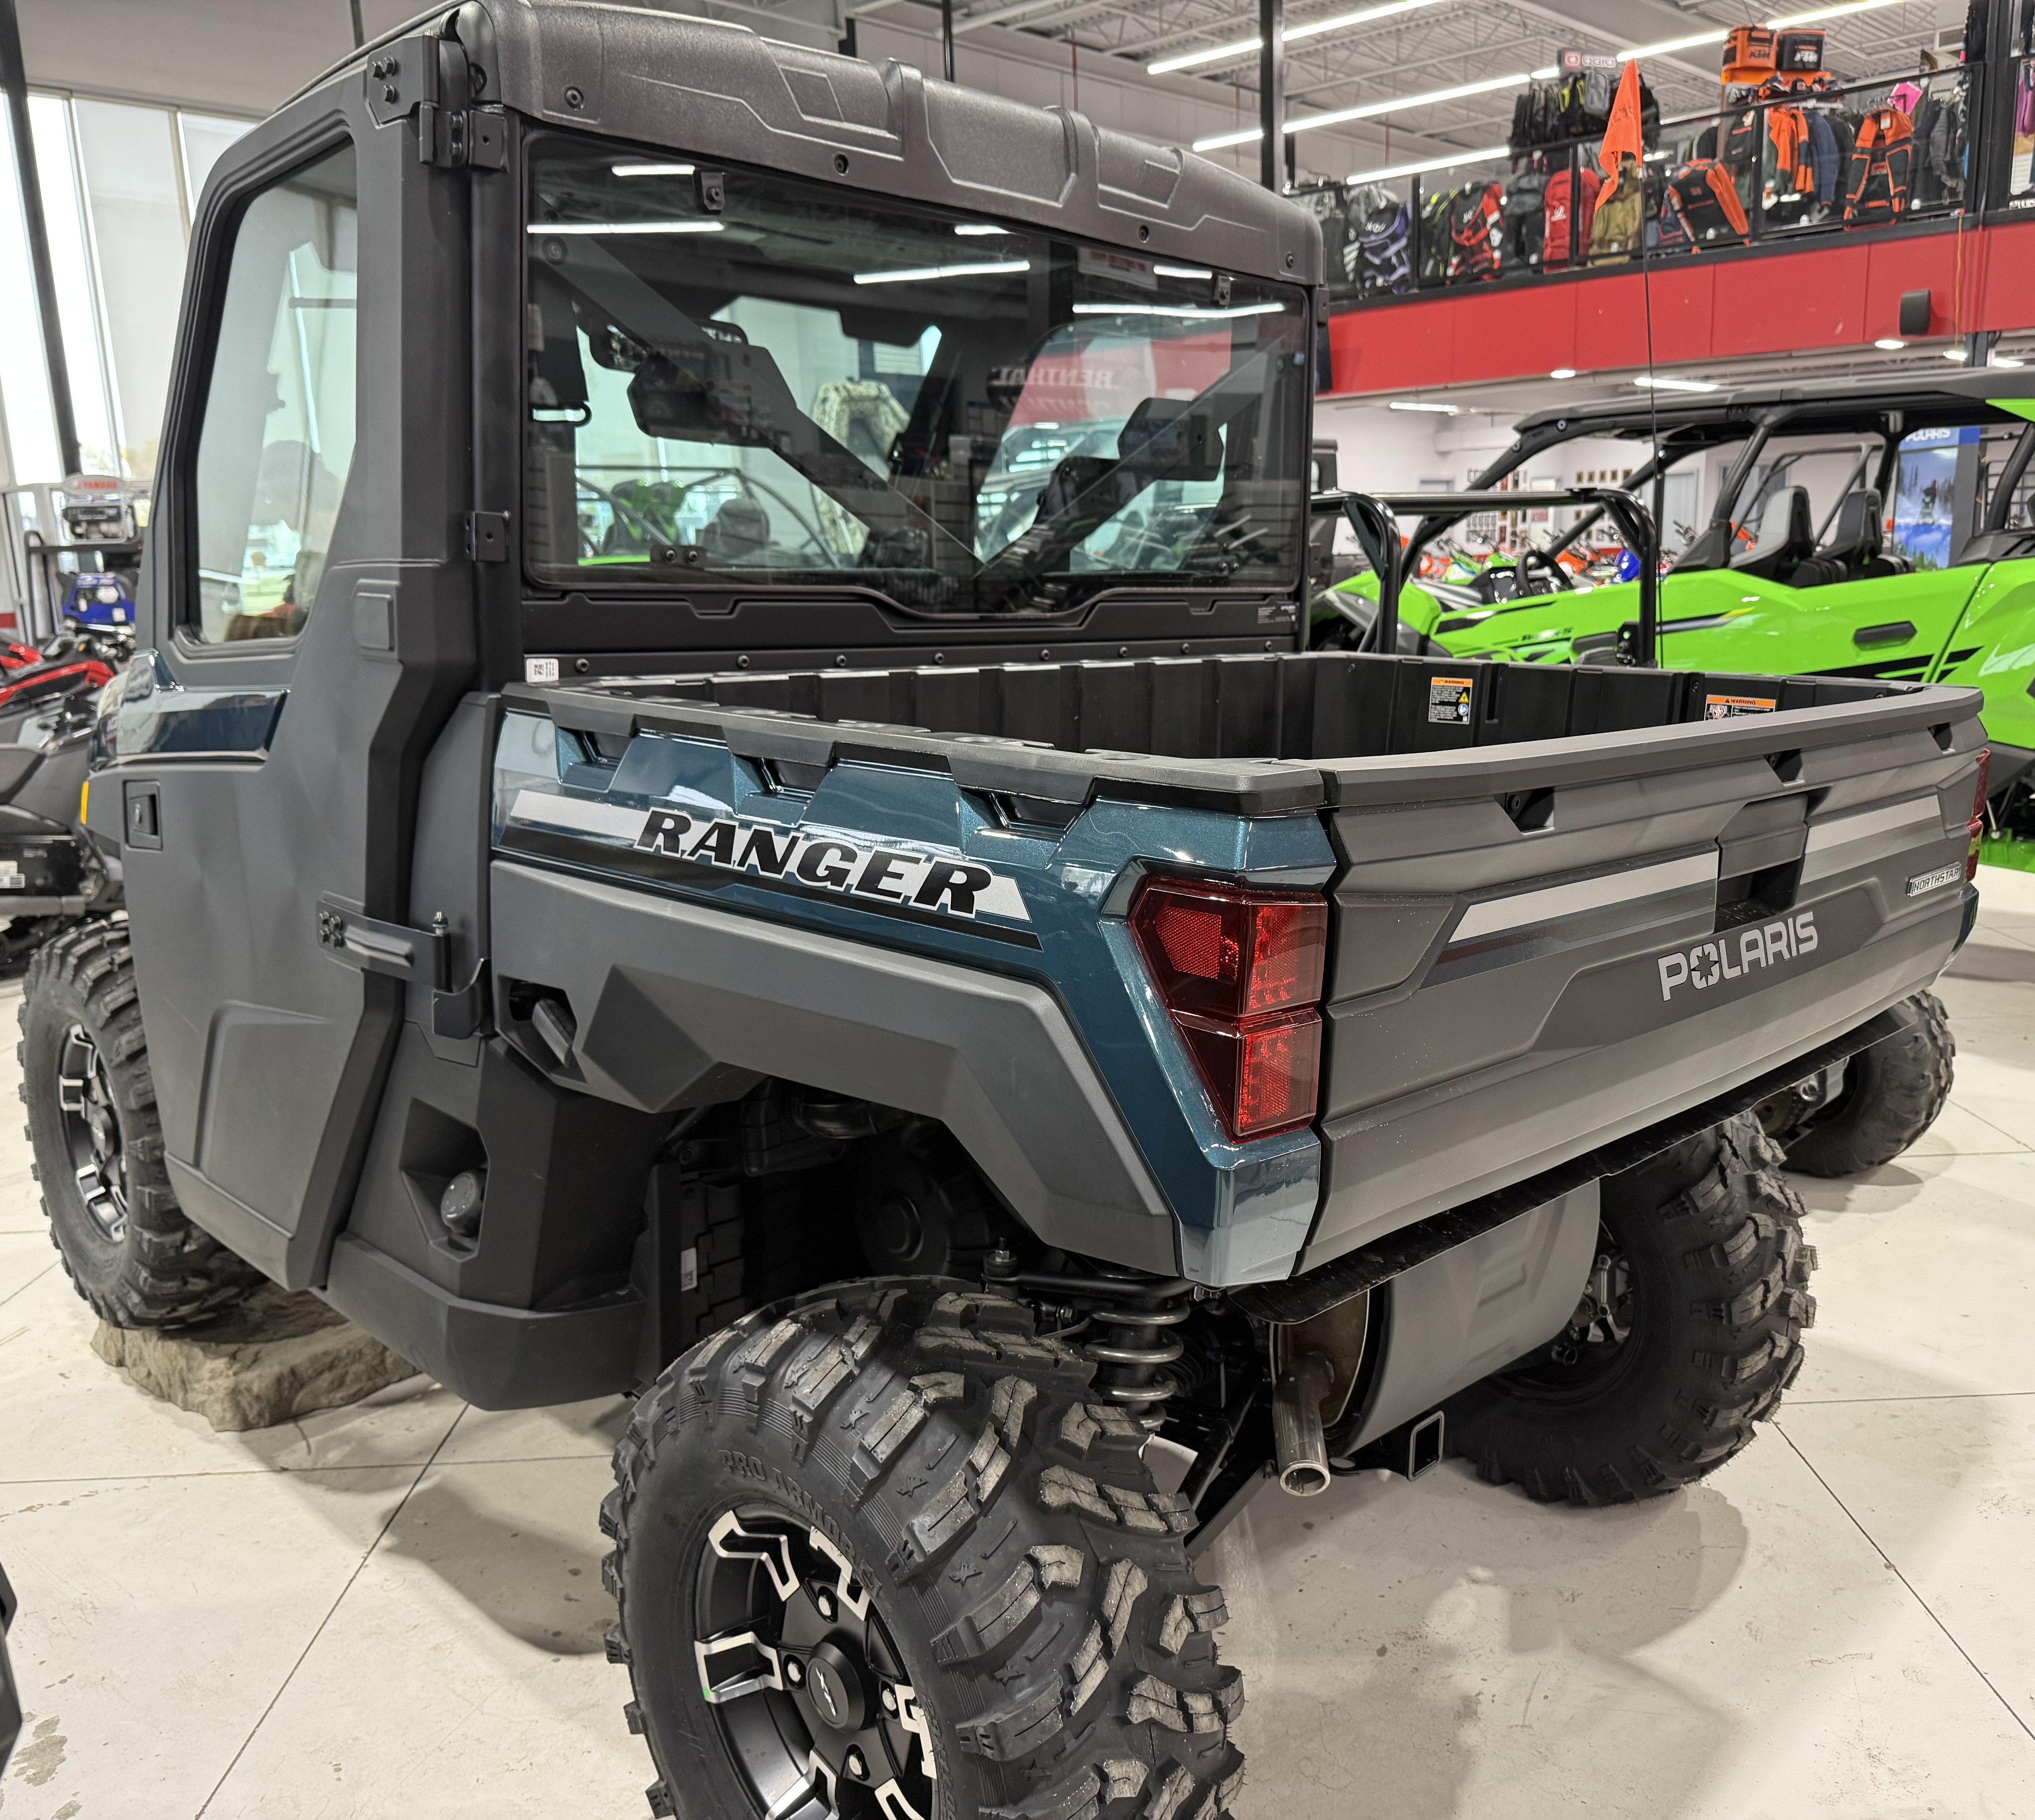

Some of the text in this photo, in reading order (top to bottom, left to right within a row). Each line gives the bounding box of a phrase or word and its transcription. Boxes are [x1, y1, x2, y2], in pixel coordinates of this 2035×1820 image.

[1749, 50, 1771, 59] KTM
[1794, 50, 1818, 62] KTM
[634, 807, 992, 918] RANGER
[1913, 868, 1959, 892] NORTHSTAR
[1658, 911, 1818, 1001] POLARIS
[718, 1450, 767, 1481] PRO
